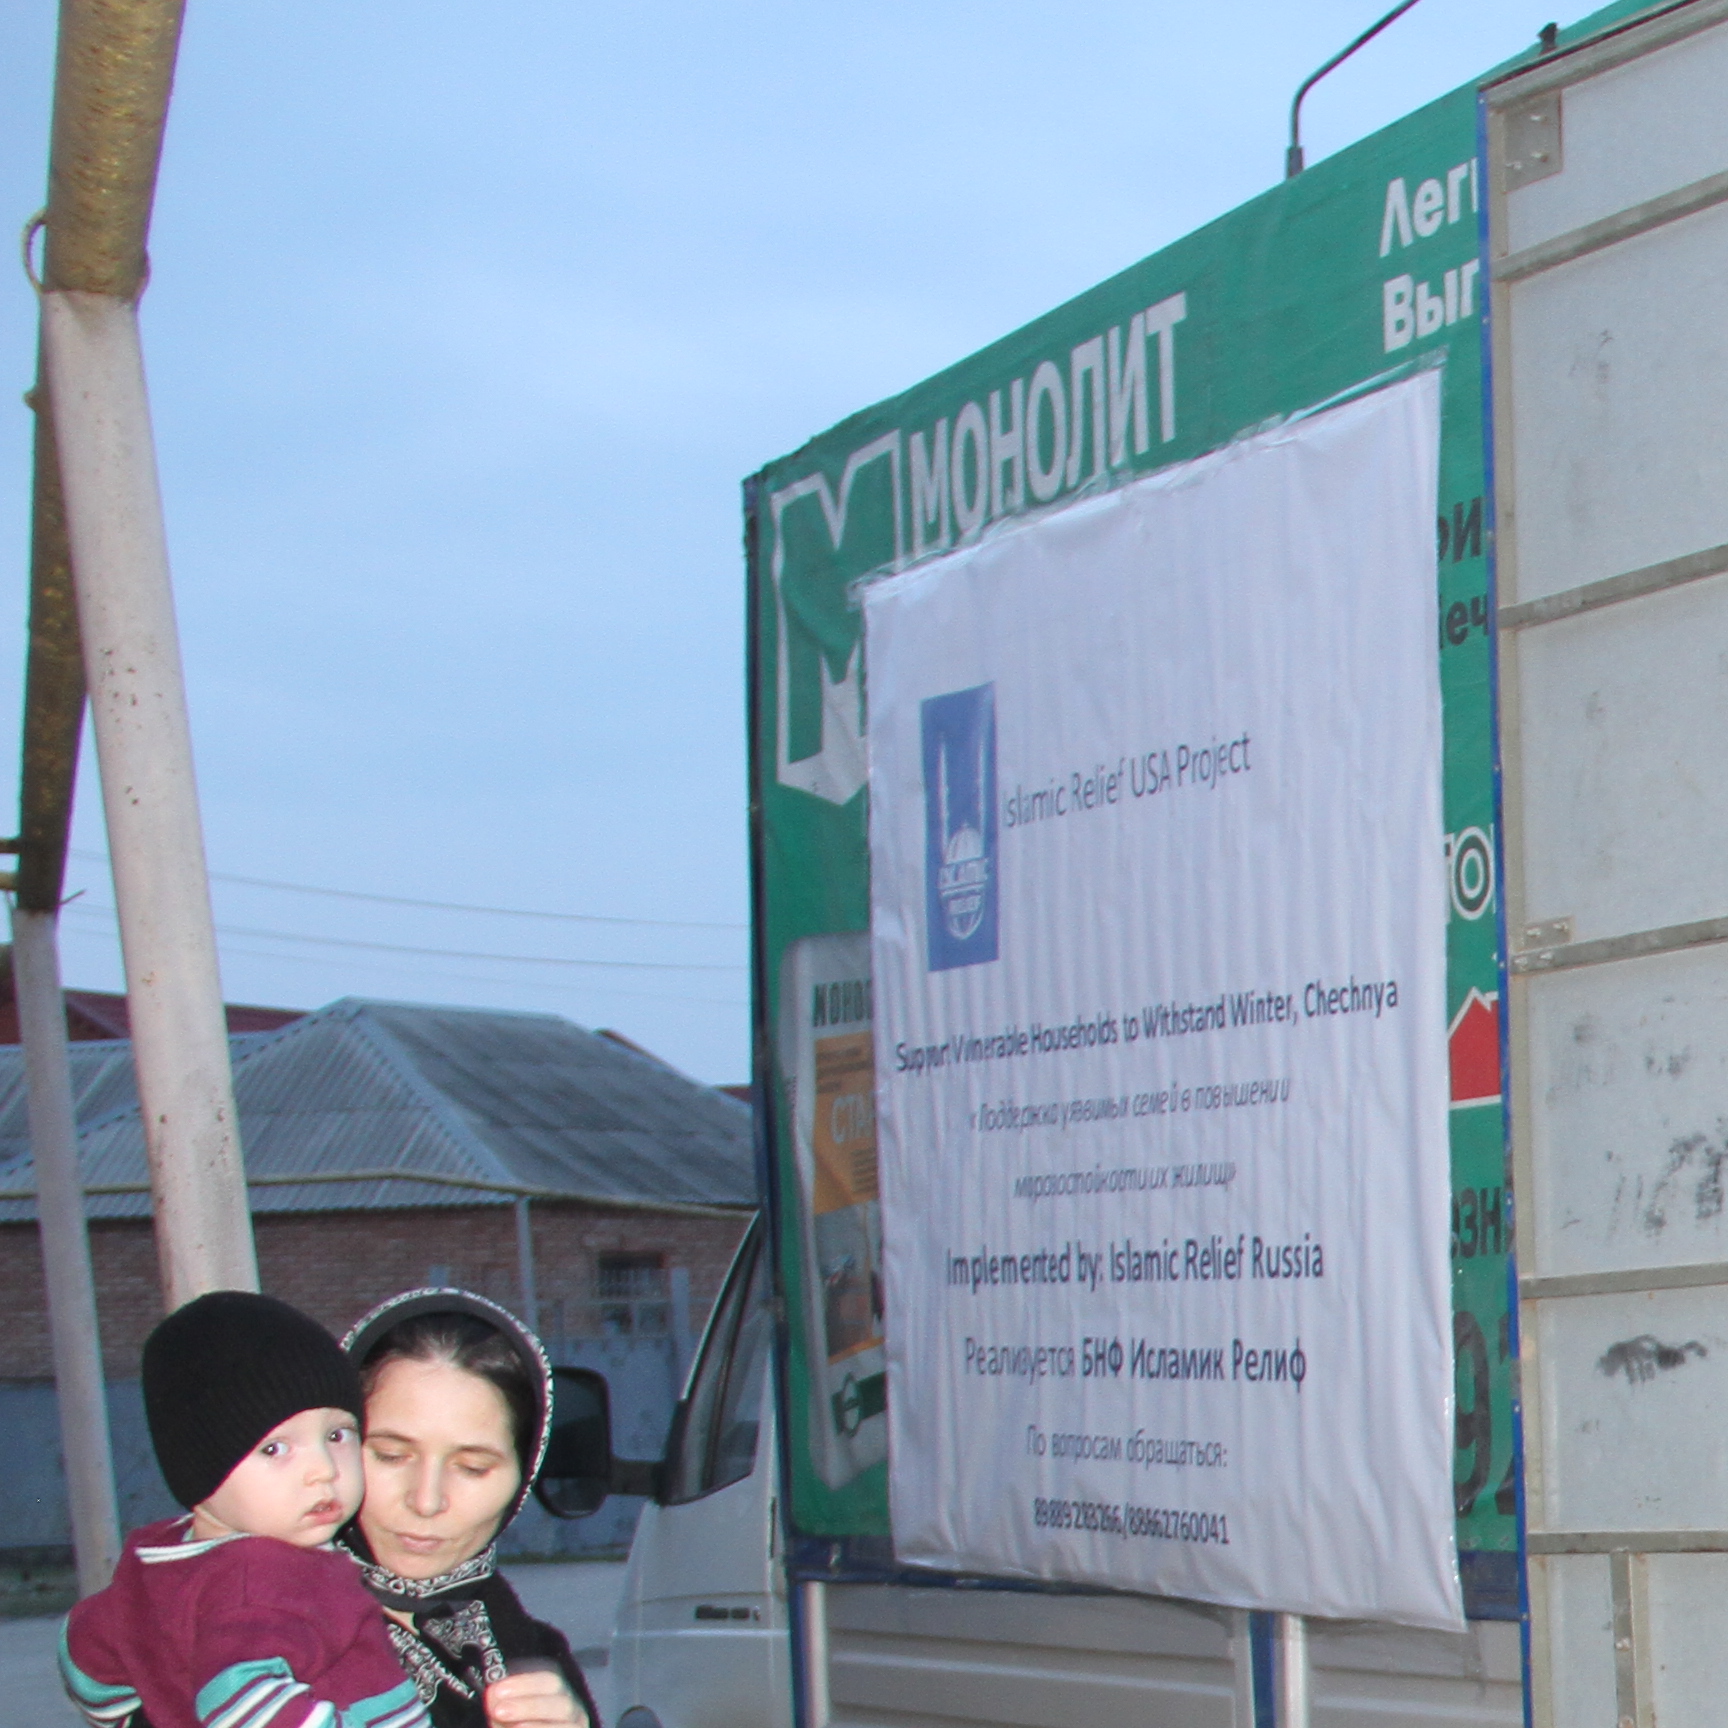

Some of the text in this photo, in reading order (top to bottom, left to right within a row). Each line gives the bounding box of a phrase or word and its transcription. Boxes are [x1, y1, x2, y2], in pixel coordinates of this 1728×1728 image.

[908, 291, 1186, 558] МОНОЛИТ
[1071, 756, 1125, 812] Relief
[1131, 750, 1172, 799] USA
[1177, 731, 1251, 790] Project
[1030, 1012, 1118, 1051] Households
[1123, 1014, 1139, 1043] to
[1142, 996, 1226, 1039] Withstand
[1229, 988, 1298, 1027] Winter,
[1304, 975, 1398, 1018] Chechnya
[1195, 1077, 1290, 1112] повышении
[947, 1232, 1323, 1295] Implemented by: Islamic Relief Russia
[965, 1335, 1306, 1393] Реализуется БНФ Исламик Релиф
[1052, 1432, 1122, 1465] вопросам
